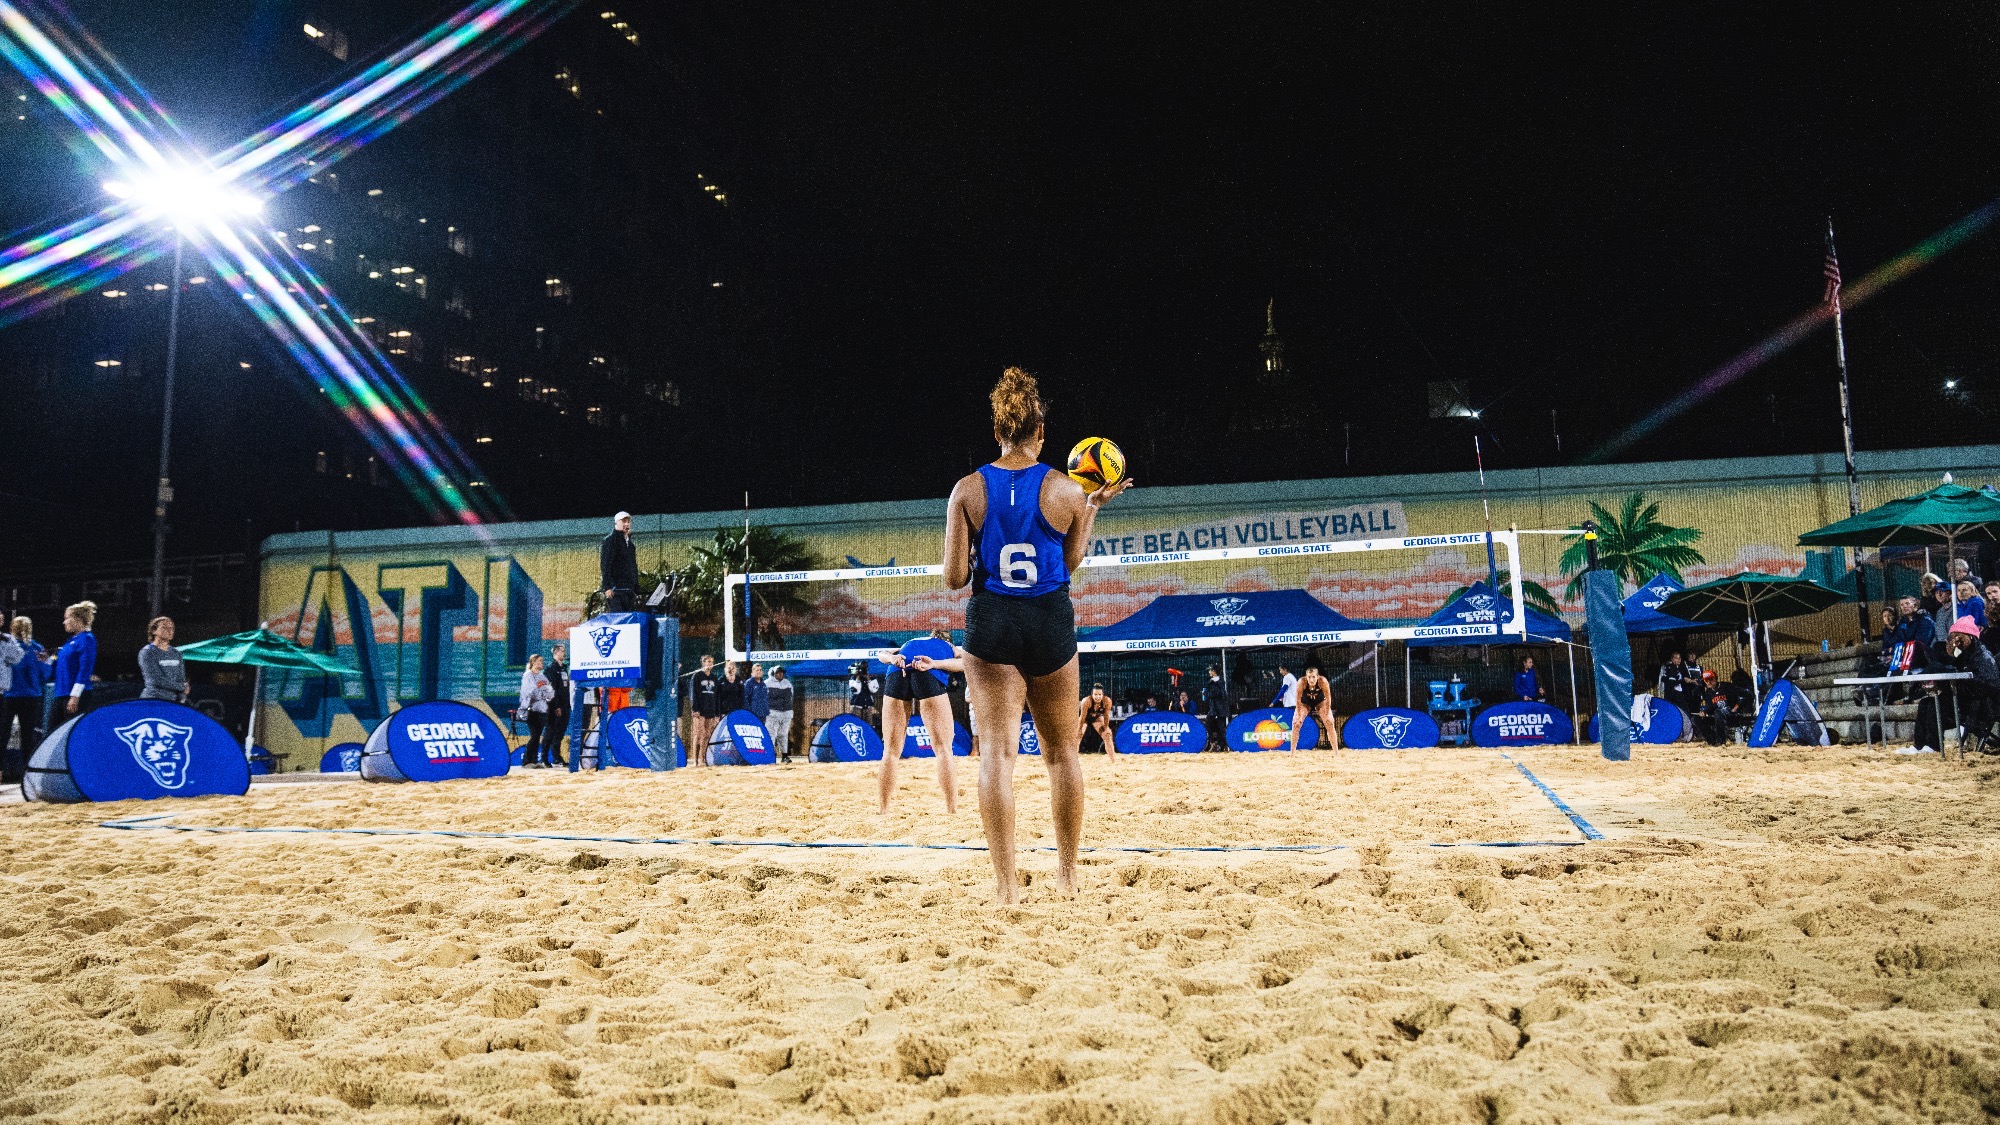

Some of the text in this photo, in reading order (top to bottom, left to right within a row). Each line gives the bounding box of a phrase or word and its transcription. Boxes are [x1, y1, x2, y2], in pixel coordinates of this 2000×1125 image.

[1143, 527, 1227, 553] BEACH
[1234, 509, 1396, 545] VOLLEYBALL
[1403, 534, 1481, 547] GEORGIA STATE
[1258, 544, 1332, 556] GEORGIA STATE
[1120, 553, 1190, 564] GEORGIA STATE
[999, 543, 1037, 588] 6
[749, 572, 808, 582] GEORGIA STATE
[865, 566, 928, 577] GEORGIA STATE
[1196, 615, 1256, 623] GEORGIA
[1457, 610, 1511, 618] GEORGA
[278, 554, 544, 718] ATL
[1414, 625, 1492, 637] GEORGIA STATE
[1266, 632, 1342, 643] GEORGIA STATE
[1126, 639, 1198, 649] GEORGIA STATE
[750, 651, 810, 660] GEORGIA STATE
[587, 668, 624, 678] COURT 1
[1488, 713, 1553, 727] GEORGIA
[406, 722, 485, 741] GEORGIA
[1131, 722, 1190, 733] GEORGIA
[1499, 724, 1545, 736] STATE
[1140, 732, 1181, 743] STATE
[1244, 731, 1292, 742] LOTTER
[424, 740, 479, 758] STATE
